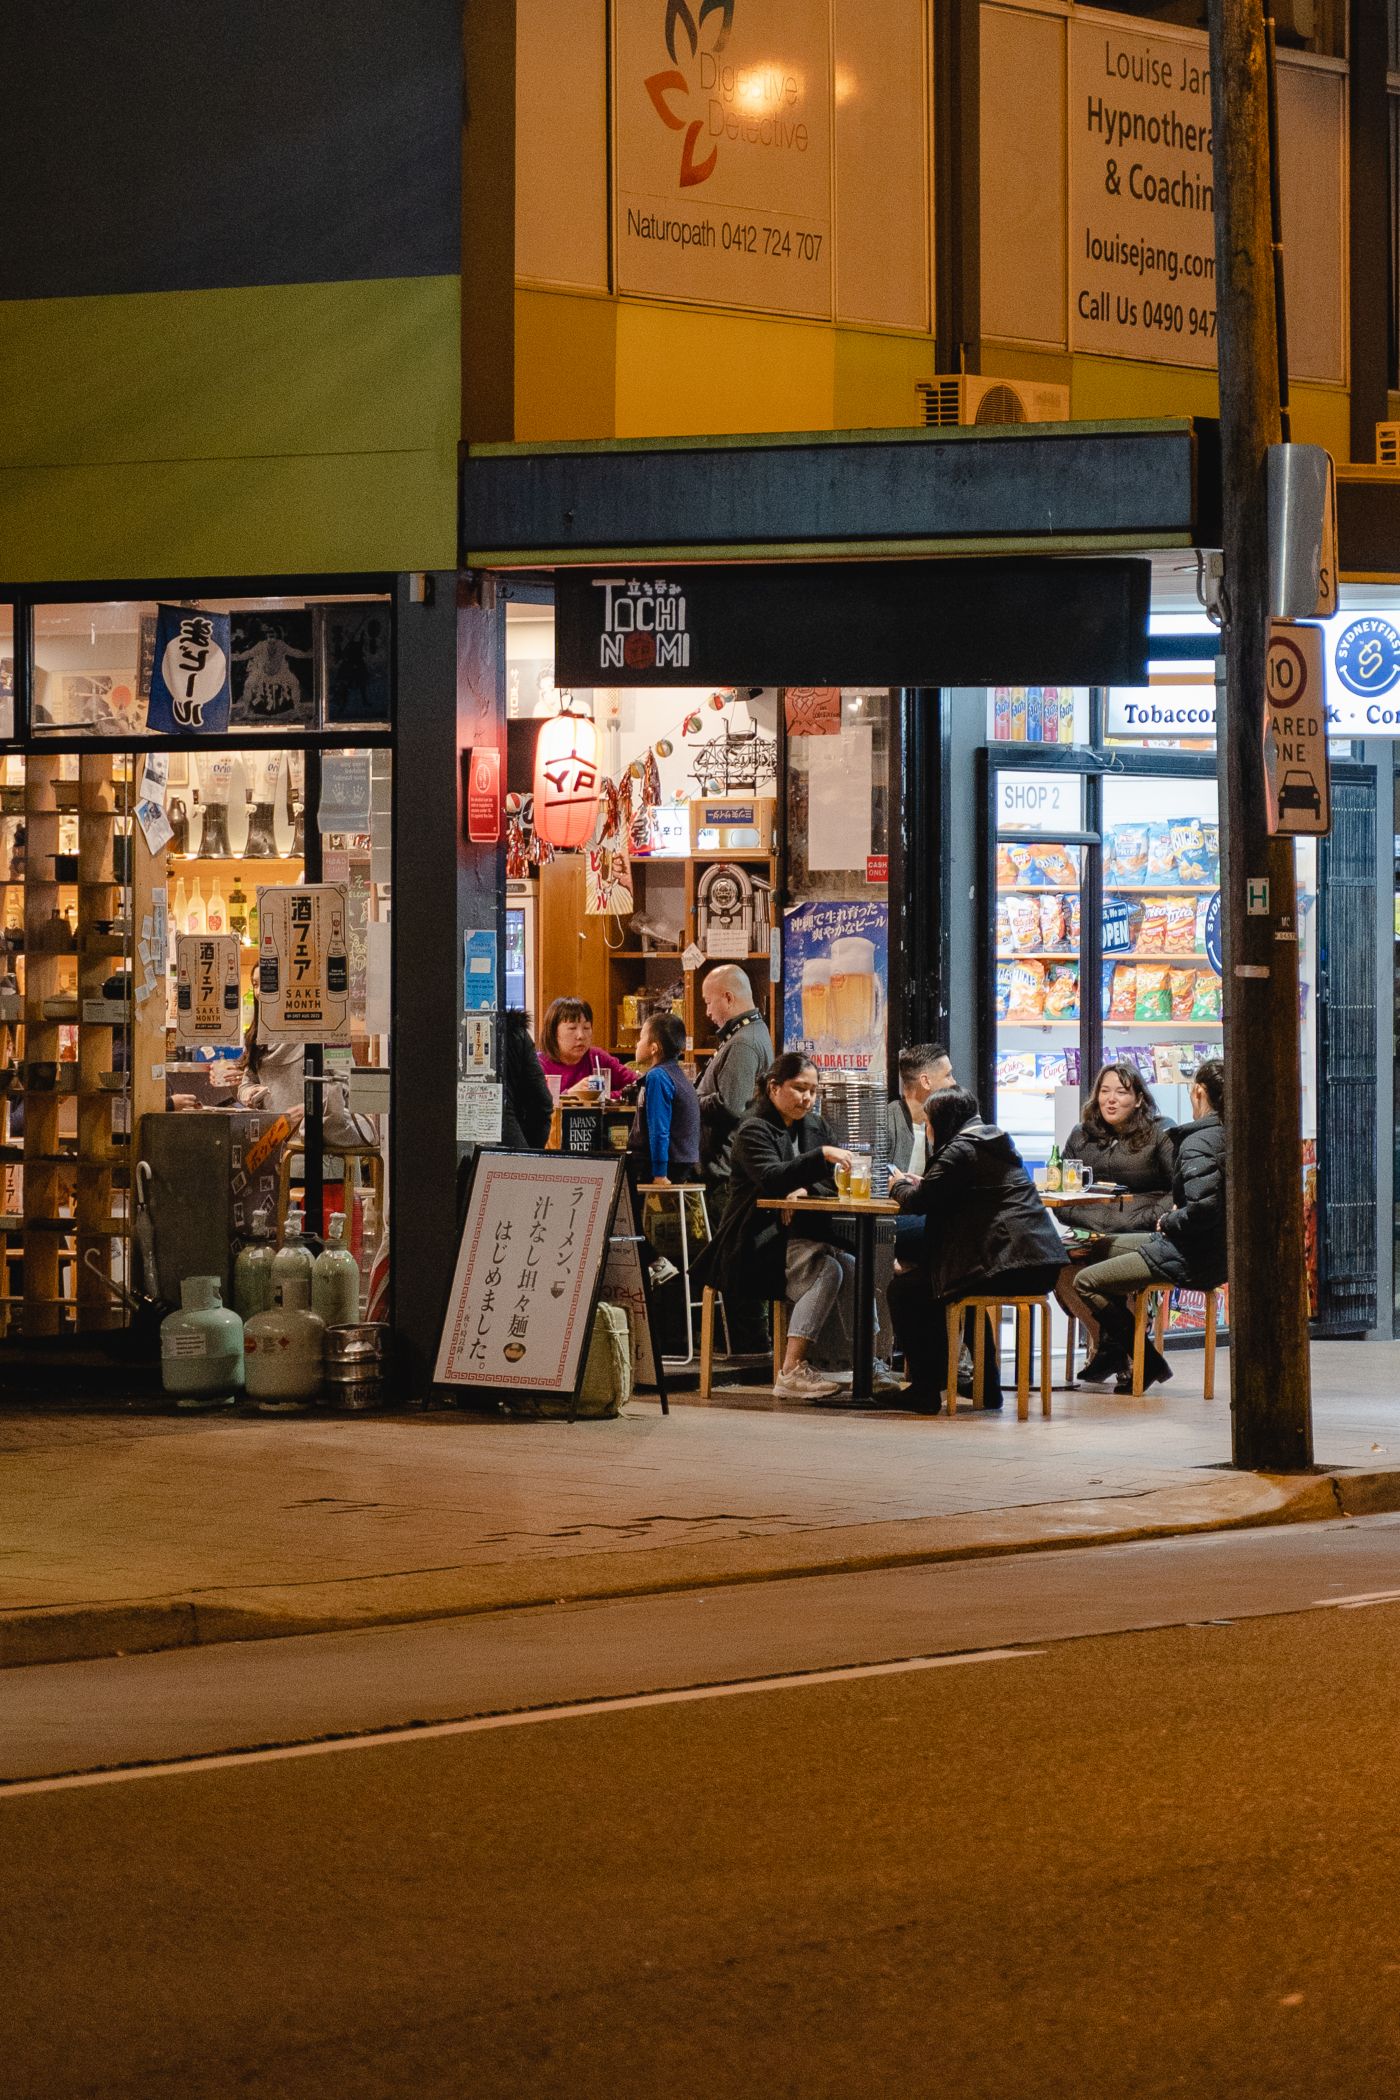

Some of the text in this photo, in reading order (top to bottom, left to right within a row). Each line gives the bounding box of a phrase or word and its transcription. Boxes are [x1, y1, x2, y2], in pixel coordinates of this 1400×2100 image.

[1105, 41, 1172, 88] Louise
[700, 52, 799, 105] Digestive
[708, 99, 809, 152] Detective
[1105, 158, 1121, 196] &
[627, 208, 823, 262] Naturopath 0412 724 707
[1078, 290, 1217, 338] Call Us 0490 947
[1270, 658, 1293, 688] 10
[1277, 743, 1306, 762] NE
[1004, 785, 1060, 809] SHOP 2
[1250, 885, 1267, 908] H
[291, 895, 312, 981] 酒フェア
[811, 917, 886, 943] 爽やかなビール
[200, 942, 215, 1002] 酒フェア
[286, 989, 321, 999] SAKE
[286, 1000, 321, 1009] MONTH
[196, 1007, 221, 1015] SAKE
[824, 1054, 854, 1067] DRAFT
[569, 1116, 597, 1129] JAPAN'S
[569, 1129, 594, 1142] FINES
